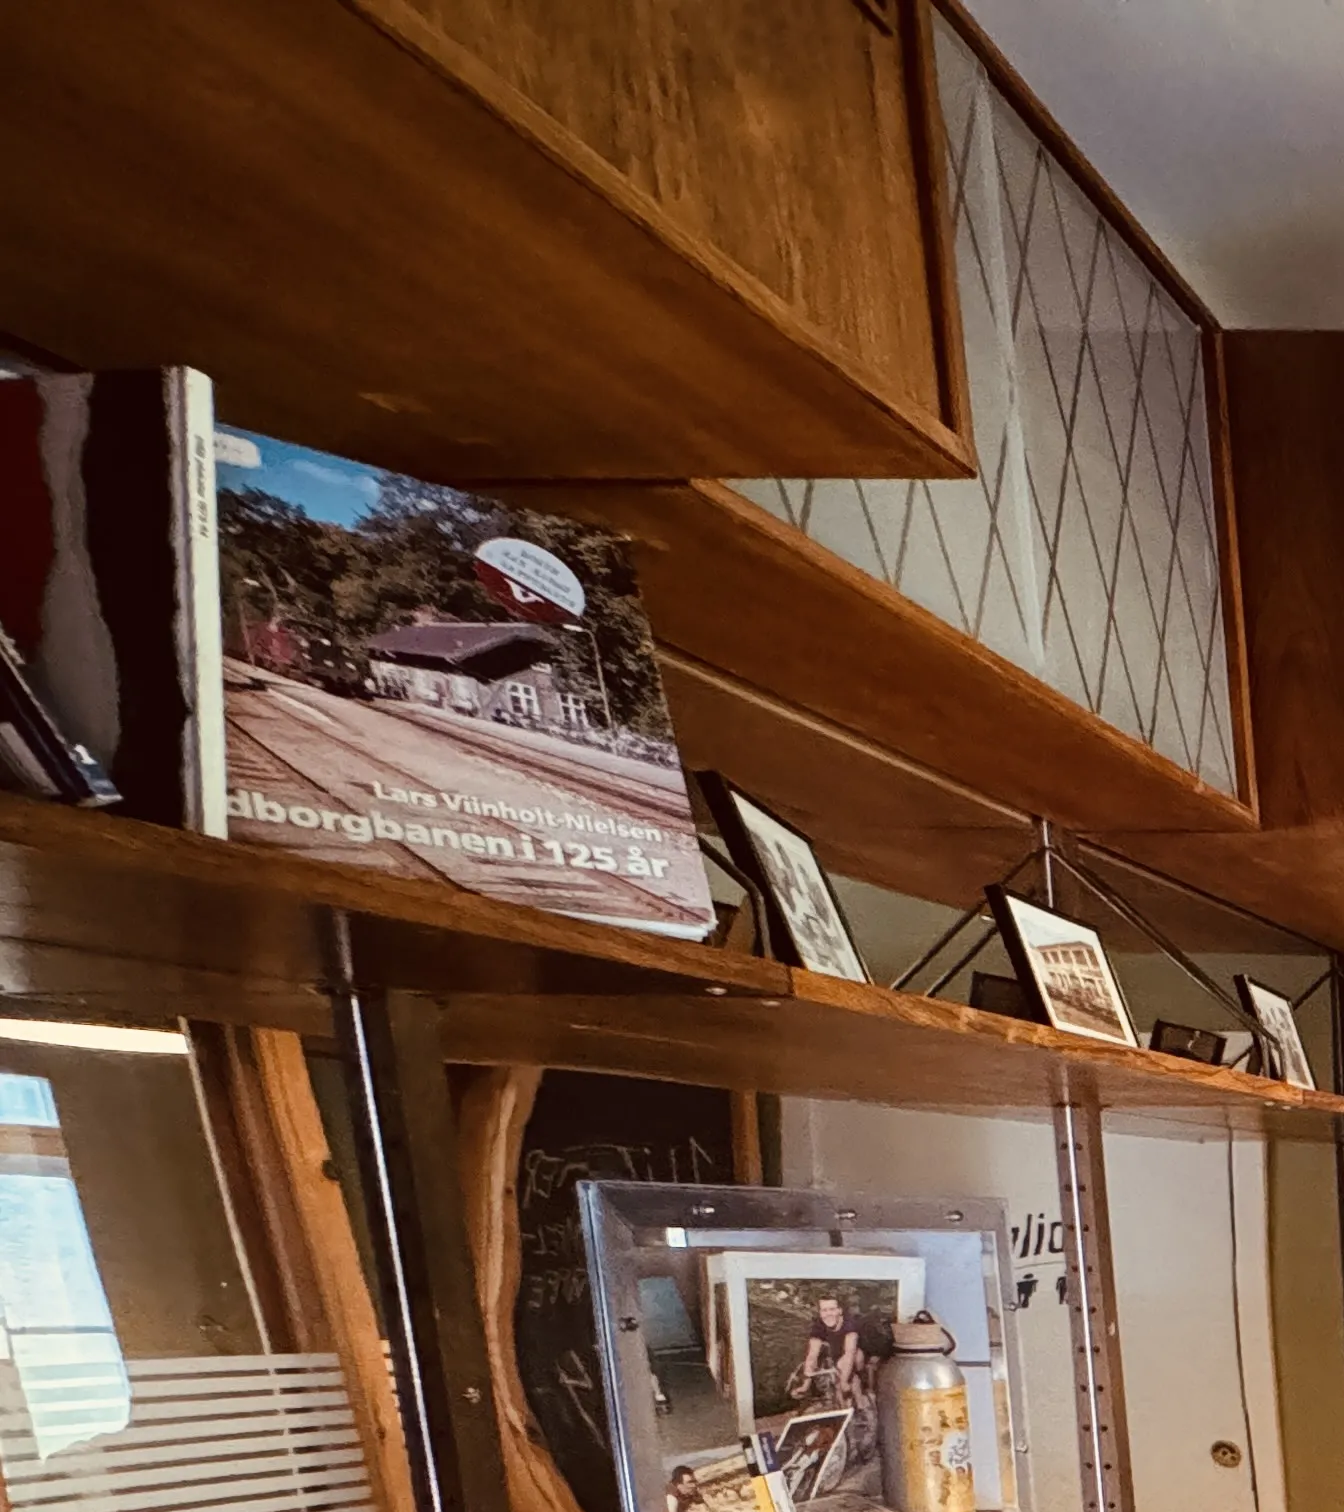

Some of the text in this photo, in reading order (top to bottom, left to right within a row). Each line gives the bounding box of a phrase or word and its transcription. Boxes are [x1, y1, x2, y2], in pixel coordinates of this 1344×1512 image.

[372, 779, 664, 844] Lars Viinholt-Nielsen
[523, 834, 536, 862] i
[547, 839, 618, 872] 125
[627, 846, 671, 879] år
